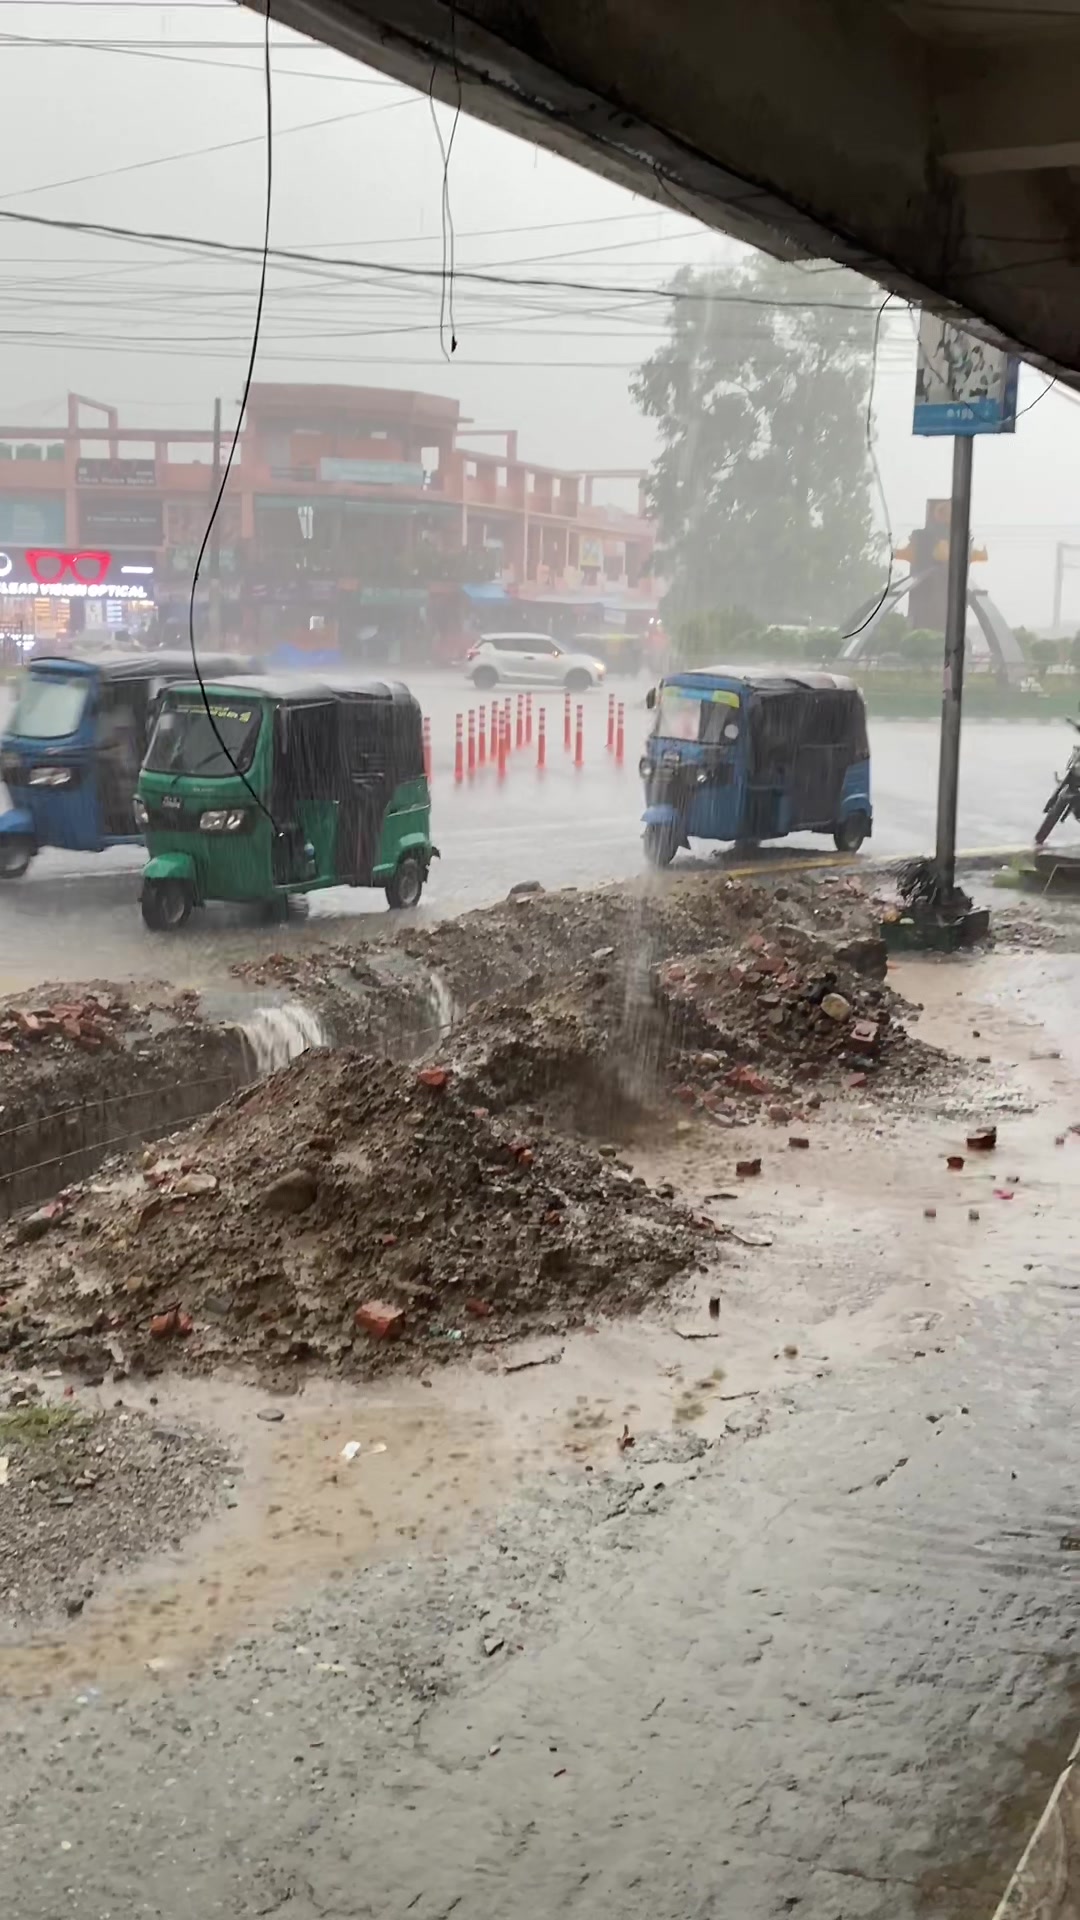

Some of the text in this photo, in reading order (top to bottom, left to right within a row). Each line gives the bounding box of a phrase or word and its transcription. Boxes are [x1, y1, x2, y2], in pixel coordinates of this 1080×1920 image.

[0, 582, 147, 598] LEAR VISION OPTICAL
